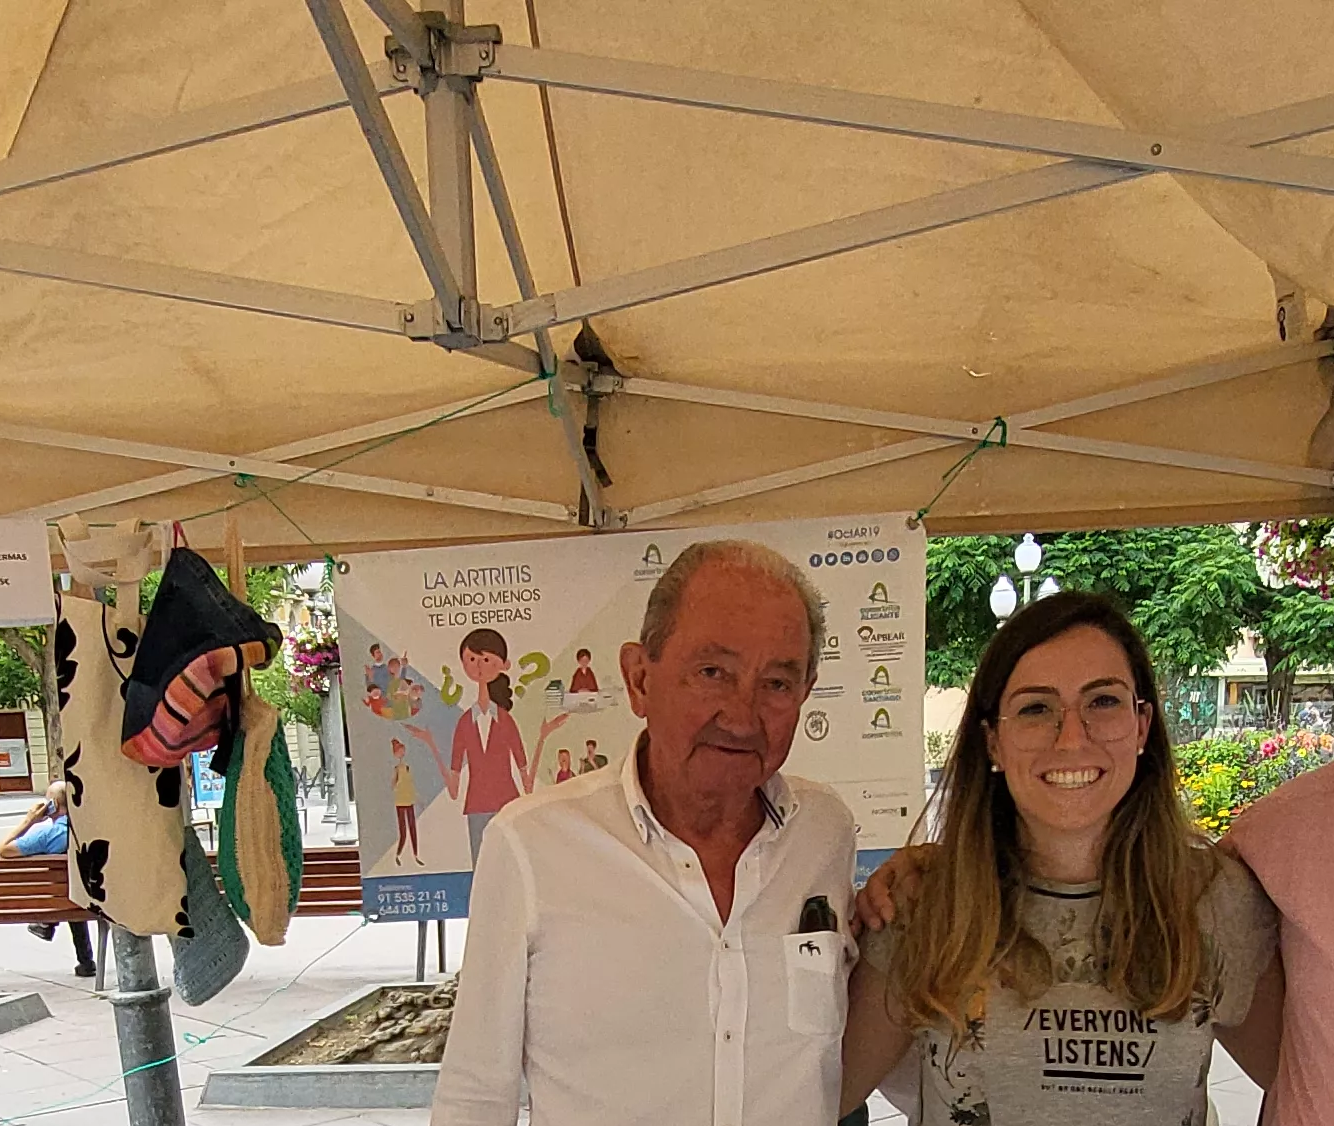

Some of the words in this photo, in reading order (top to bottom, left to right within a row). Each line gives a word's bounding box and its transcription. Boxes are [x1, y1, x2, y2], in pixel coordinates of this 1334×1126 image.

[423, 571, 449, 590] LA
[453, 565, 532, 588] ARTRITIS
[421, 592, 486, 609] CUANDO
[489, 588, 541, 605] MENOS
[429, 613, 444, 627] TE
[448, 611, 467, 626] LO
[472, 607, 532, 624] ESPERAS
[378, 893, 390, 904] 91
[395, 892, 415, 902] 535
[418, 891, 430, 901] 21
[419, 903, 431, 913] 77
[1023, 1007, 1158, 1034] /EVERYONE
[1044, 1038, 1156, 1068] LISTENS/
